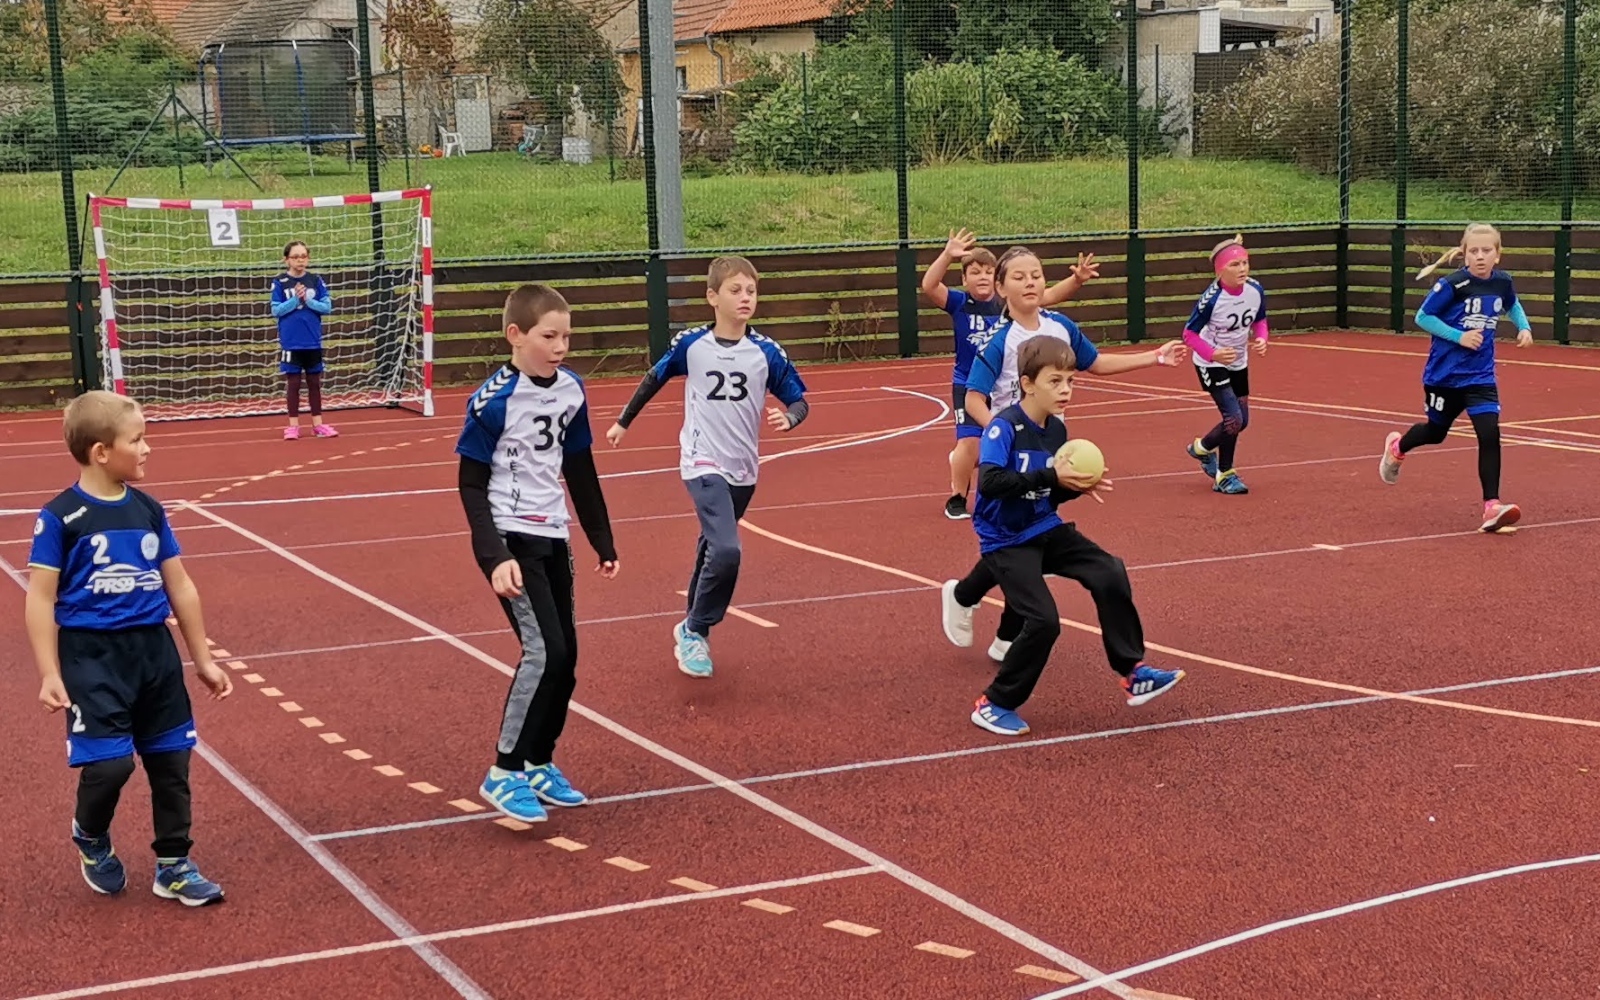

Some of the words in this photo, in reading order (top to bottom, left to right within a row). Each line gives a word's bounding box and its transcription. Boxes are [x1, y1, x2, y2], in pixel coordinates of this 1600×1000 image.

[216, 221, 233, 241] 2
[1464, 297, 1482, 314] 18
[969, 314, 985, 331] 15
[1227, 308, 1253, 331] 26
[281, 350, 291, 363] 11
[706, 370, 748, 401] 23
[1429, 392, 1445, 412] 18
[532, 410, 568, 451] 38
[1018, 452, 1030, 473] 7
[90, 534, 111, 565] 2
[71, 704, 86, 733] 2
